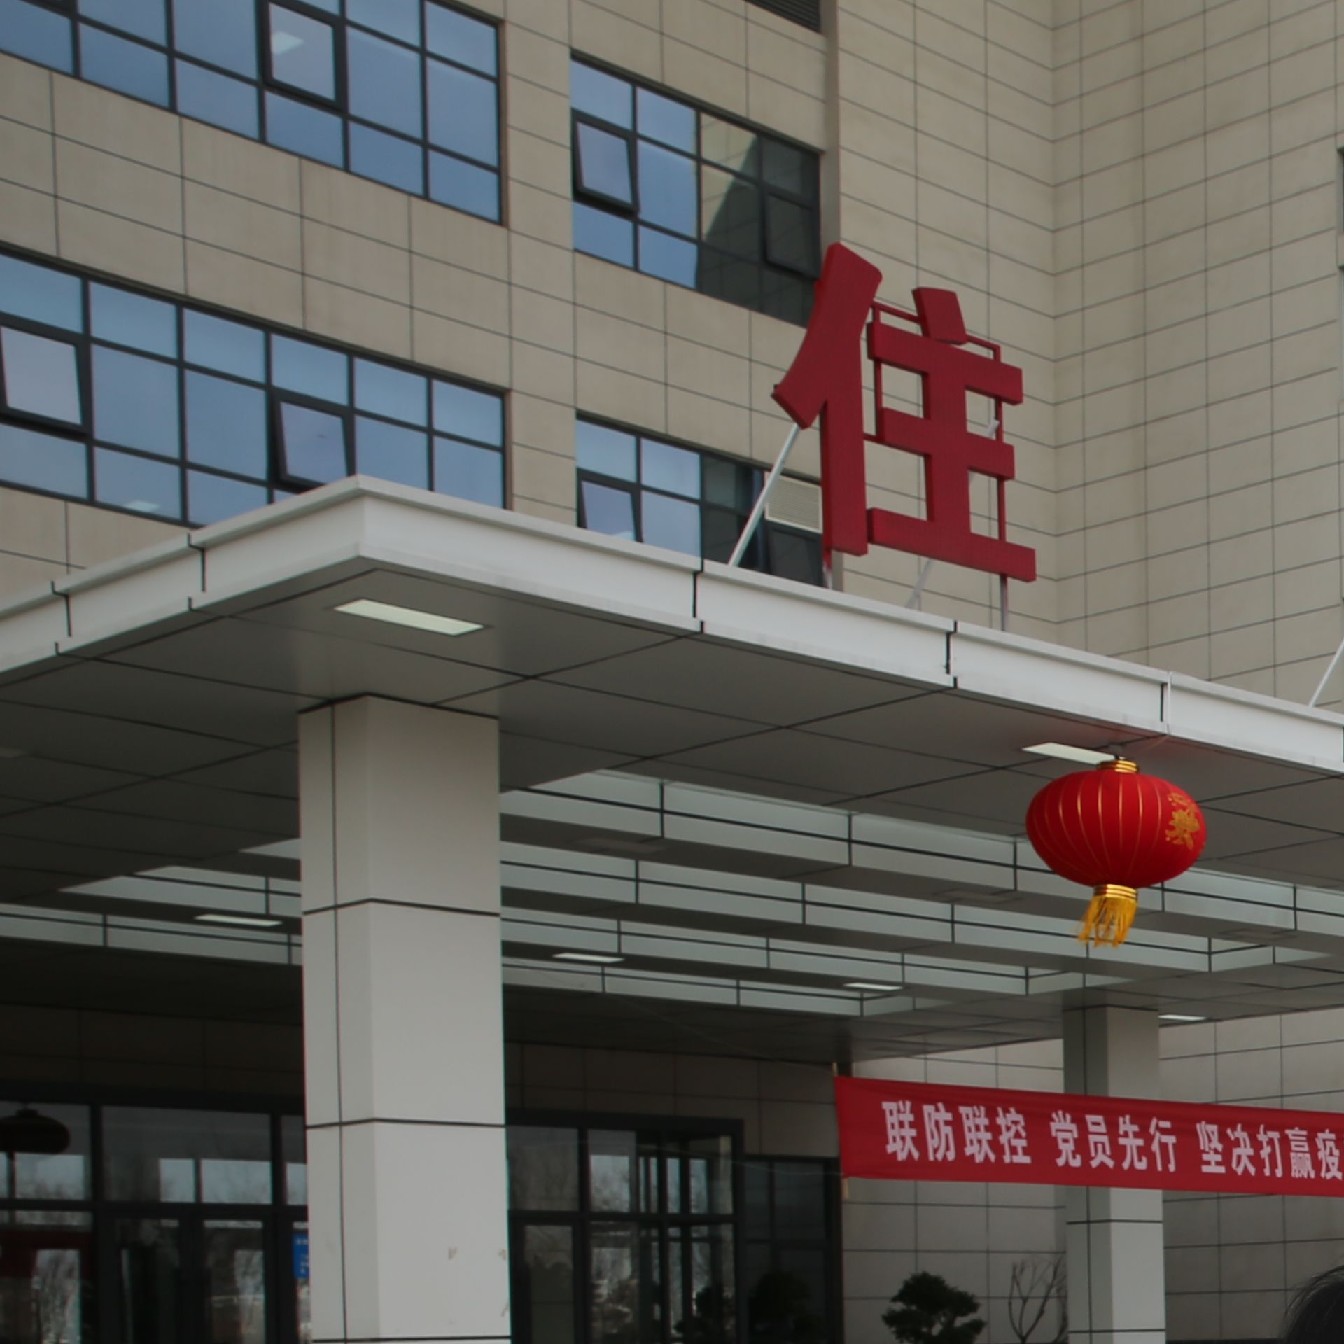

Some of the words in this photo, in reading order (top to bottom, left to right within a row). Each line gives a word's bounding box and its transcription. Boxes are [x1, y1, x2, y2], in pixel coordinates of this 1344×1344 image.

[882, 1100, 1032, 1164] 联防联控
[1049, 1111, 1177, 1173] 党员先行
